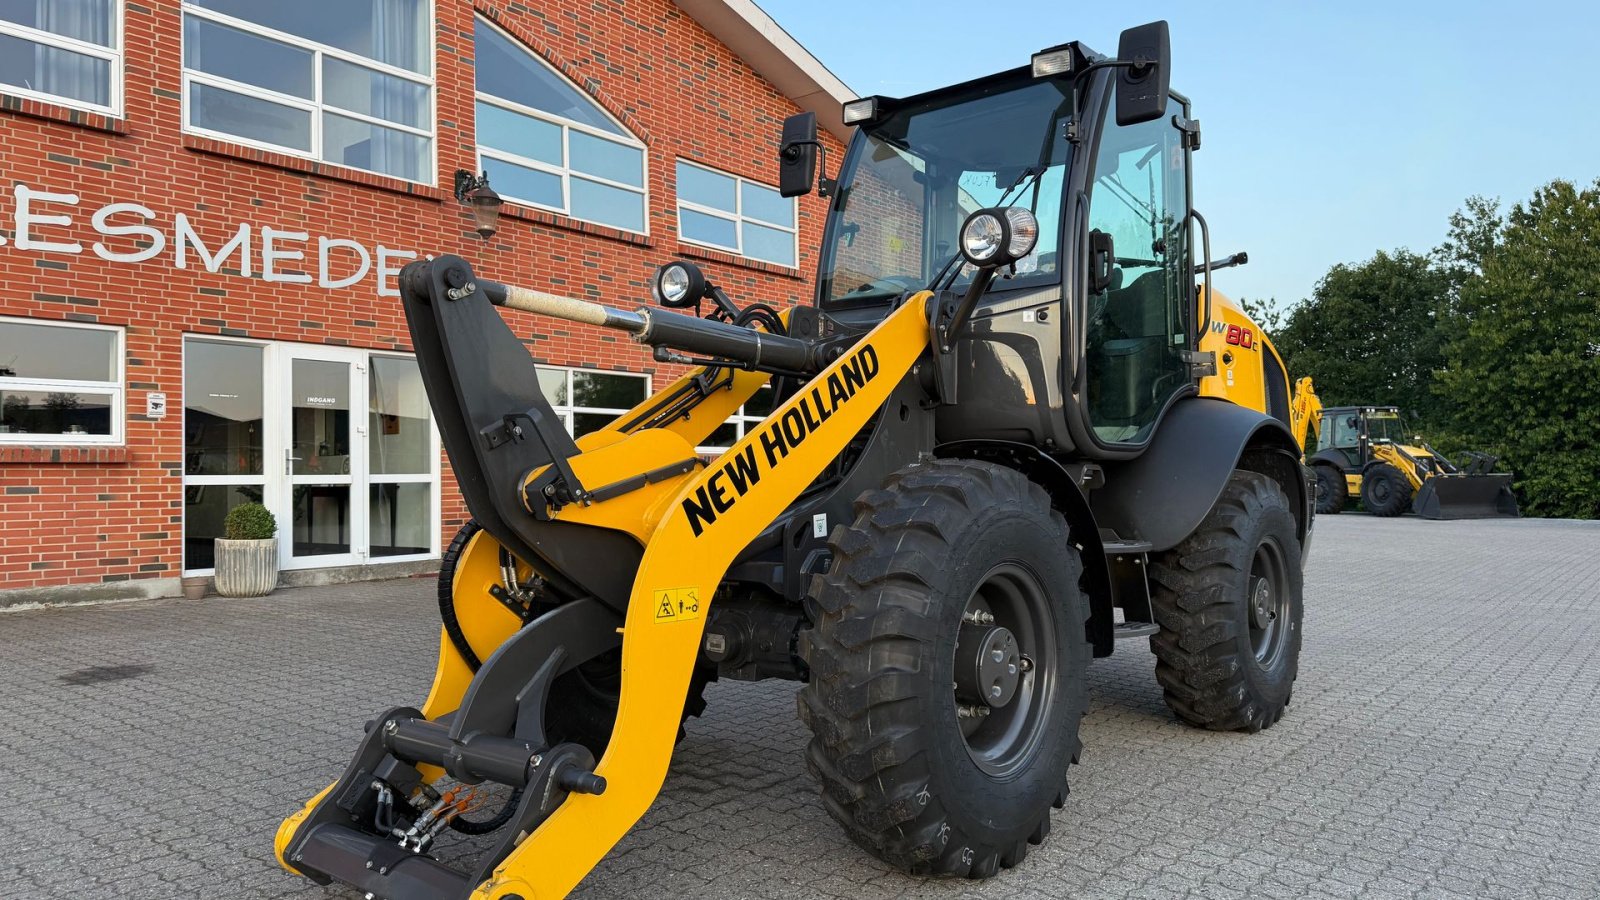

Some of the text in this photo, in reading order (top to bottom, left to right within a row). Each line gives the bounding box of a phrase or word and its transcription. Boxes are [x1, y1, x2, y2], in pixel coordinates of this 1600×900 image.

[0, 184, 434, 297] ESMEDE
[306, 396, 336, 404] INDGANG
[681, 343, 879, 538] NEW HOLLAND
